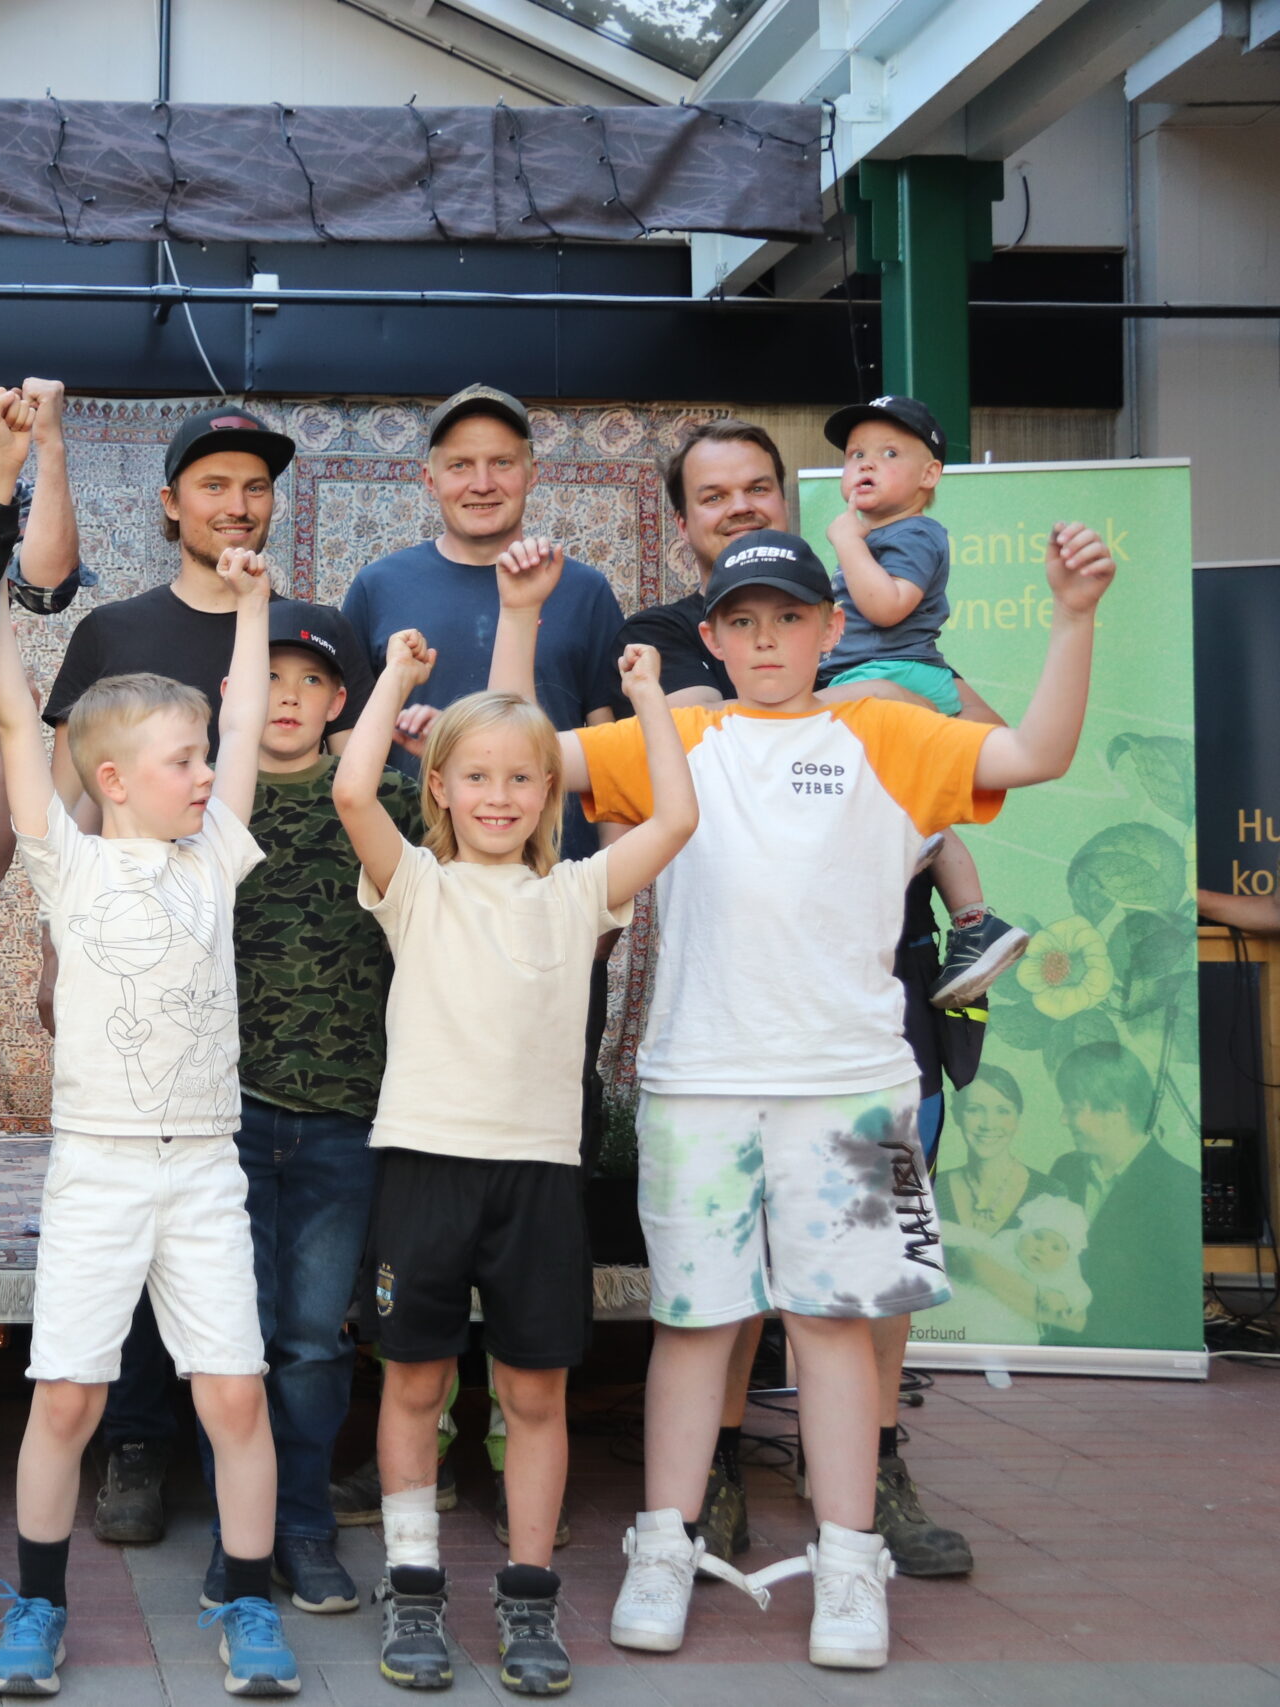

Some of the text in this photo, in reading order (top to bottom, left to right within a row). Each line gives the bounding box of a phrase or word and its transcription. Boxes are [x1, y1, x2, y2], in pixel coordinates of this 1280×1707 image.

[724, 546, 797, 568] GATEBIL
[791, 761, 845, 776] GOOD
[791, 782, 844, 795] VIBES
[910, 1325, 966, 1340] Forbund
